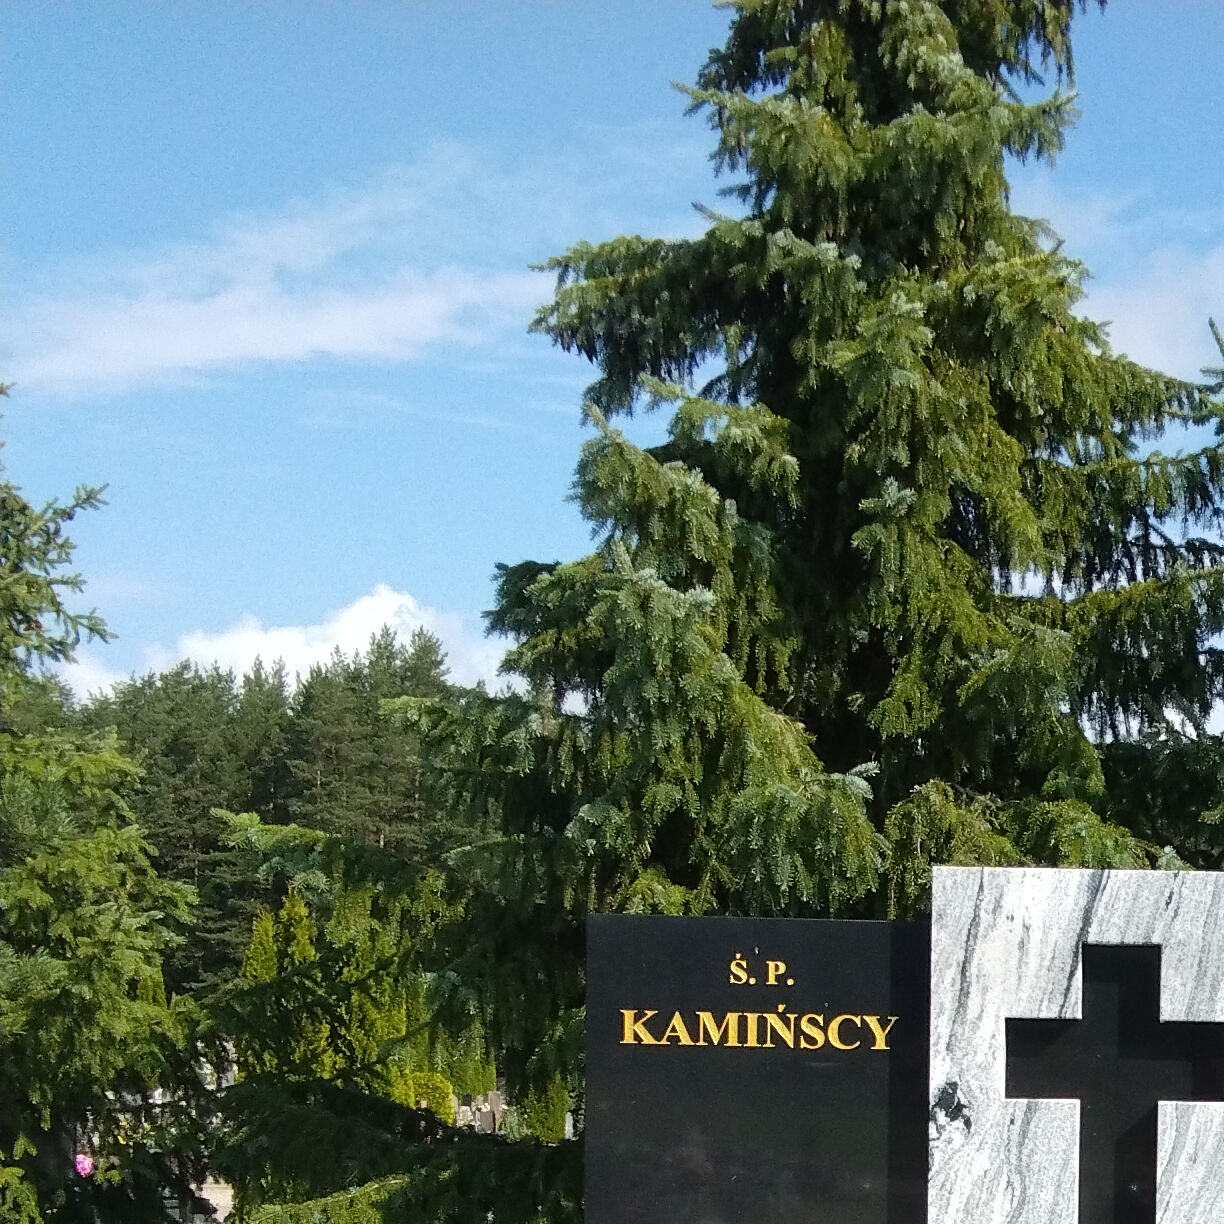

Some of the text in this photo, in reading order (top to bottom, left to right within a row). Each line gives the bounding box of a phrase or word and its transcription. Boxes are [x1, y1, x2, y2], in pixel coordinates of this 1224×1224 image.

[729, 954, 795, 985] Ś. P.
[620, 1004, 898, 1050] KAMIŃSCY
